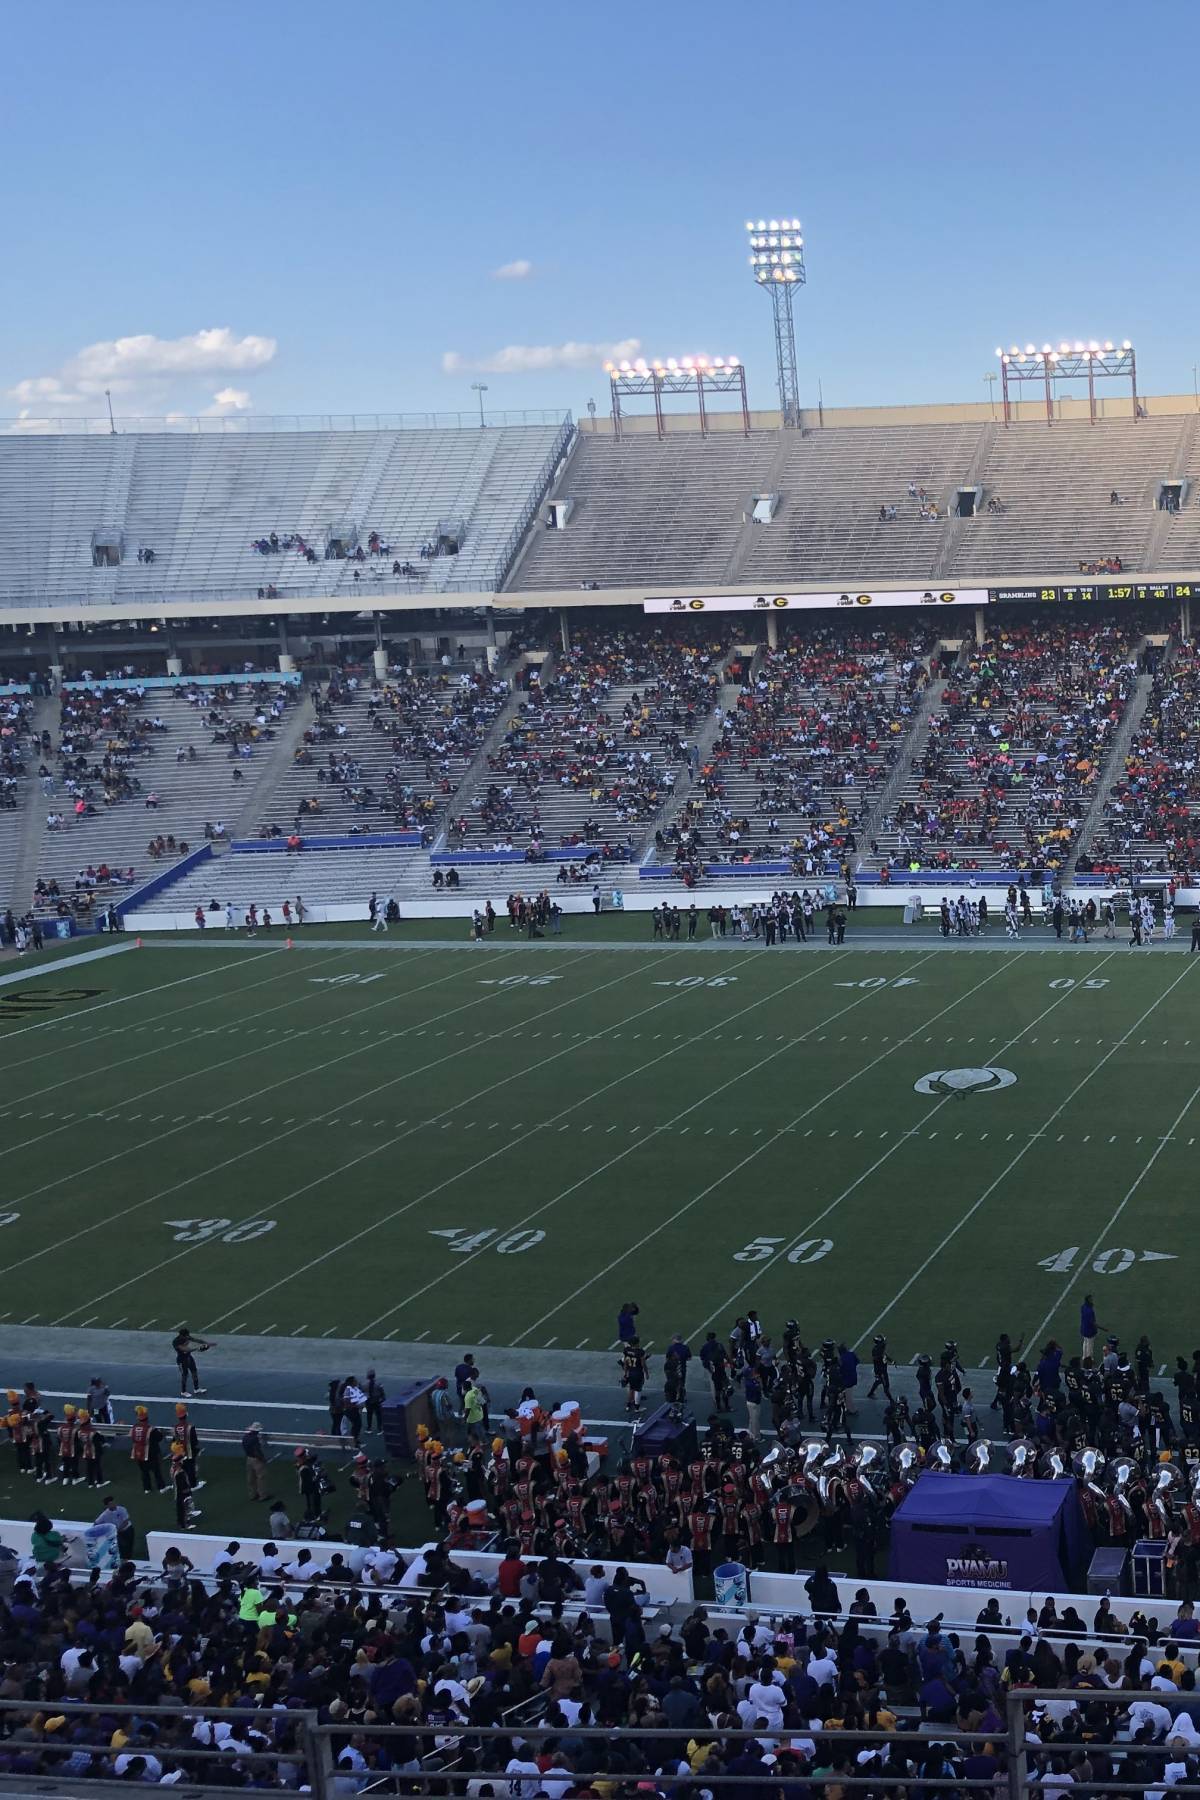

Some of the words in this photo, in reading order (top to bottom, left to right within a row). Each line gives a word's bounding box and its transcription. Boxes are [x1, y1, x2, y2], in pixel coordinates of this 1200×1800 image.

[1041, 590, 1055, 600] 23
[1108, 588, 1131, 599] 1:57
[1176, 586, 1190, 596] 24
[1048, 978, 1111, 989] 50
[173, 1218, 278, 1242] 30
[447, 1228, 546, 1254] 40
[732, 1237, 834, 1264] 50
[1037, 1246, 1136, 1274] 40
[946, 1558, 1008, 1579] PVAMU
[946, 1579, 976, 1587] SPORTS
[977, 1581, 1012, 1589] MEDICINE
